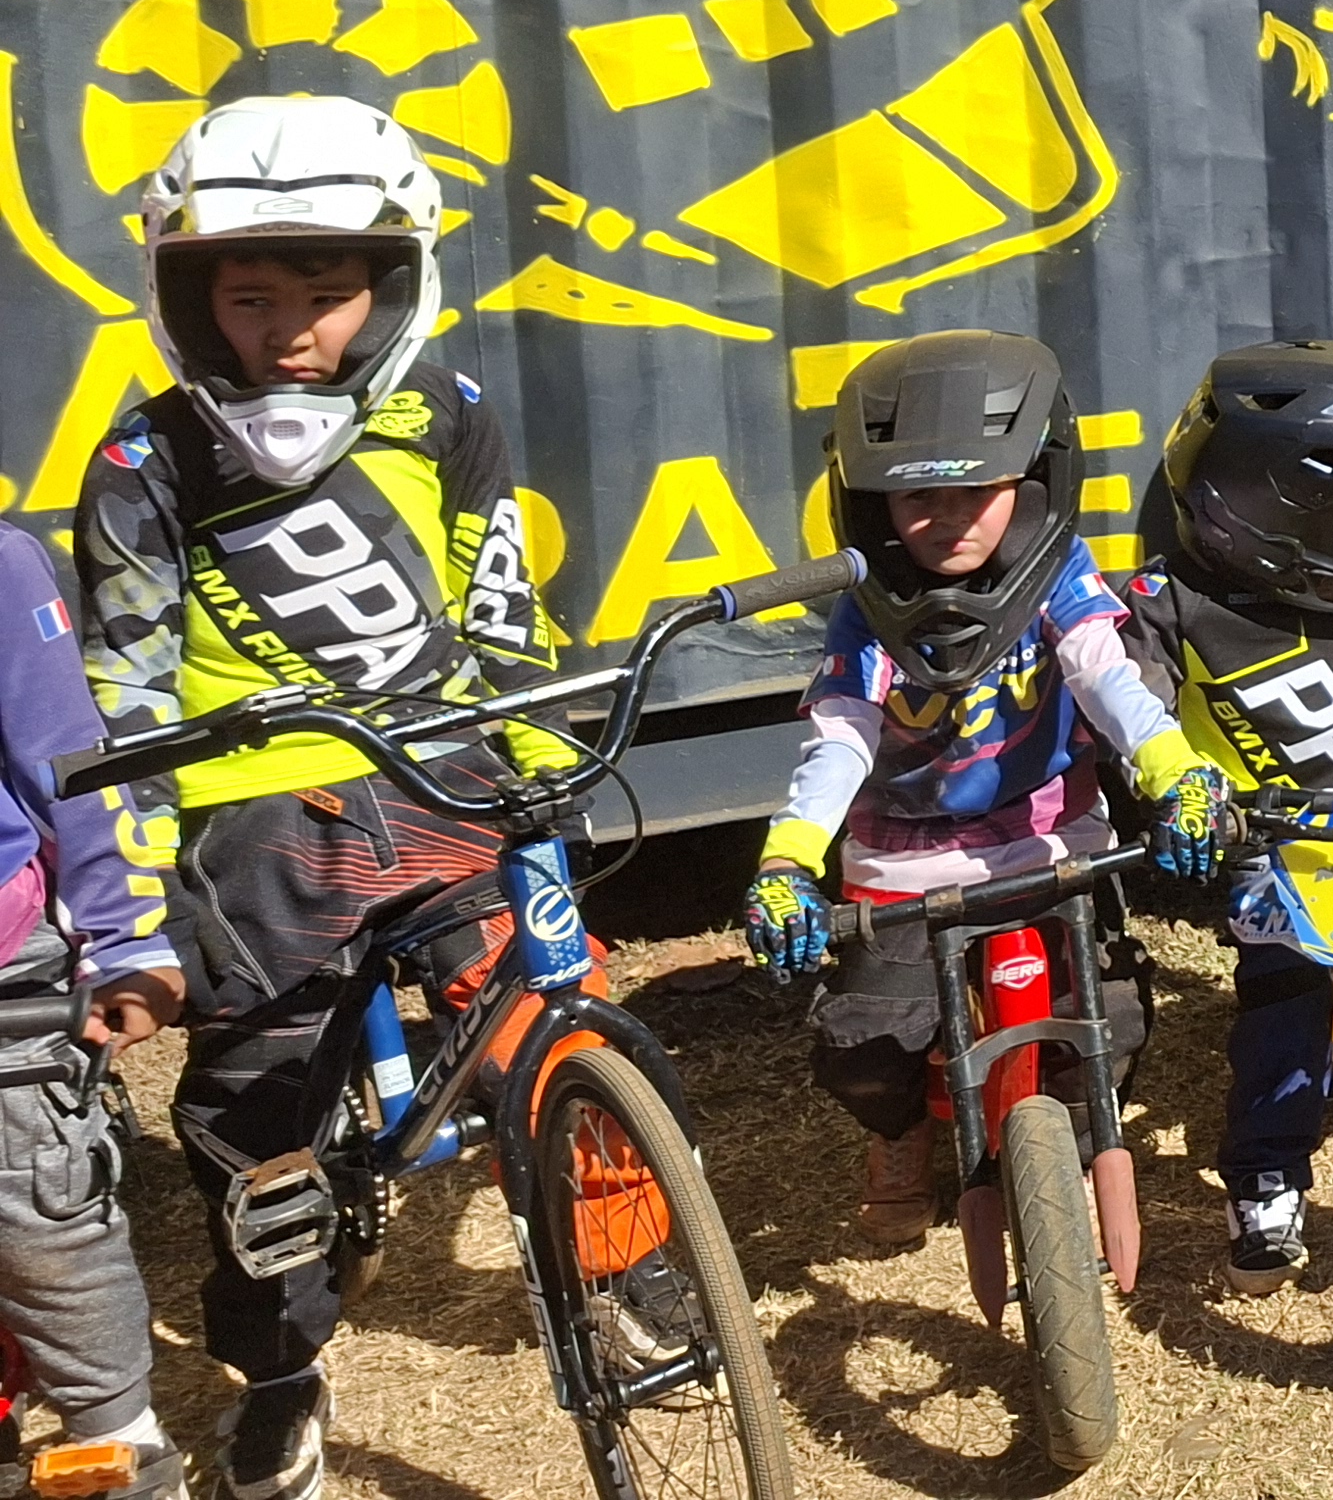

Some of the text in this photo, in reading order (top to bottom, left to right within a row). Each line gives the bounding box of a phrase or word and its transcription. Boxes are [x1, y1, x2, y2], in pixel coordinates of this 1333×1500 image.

[884, 460, 986, 477] KENNY
[190, 545, 262, 630] BMX
[212, 498, 434, 691] PPA
[1211, 700, 1279, 773] BMX
[528, 956, 593, 989] CHAS
[990, 960, 1045, 984] BERG
